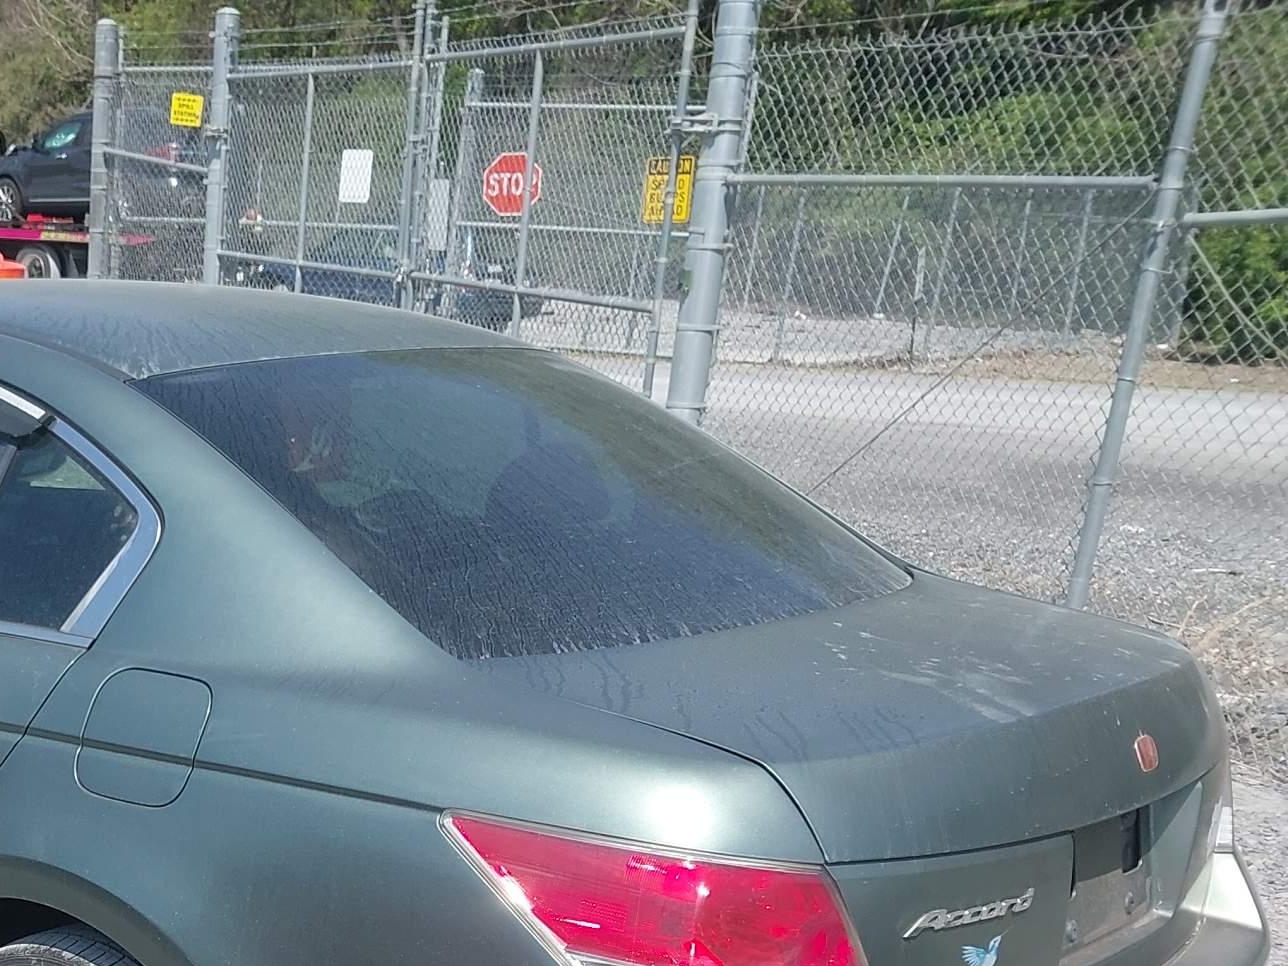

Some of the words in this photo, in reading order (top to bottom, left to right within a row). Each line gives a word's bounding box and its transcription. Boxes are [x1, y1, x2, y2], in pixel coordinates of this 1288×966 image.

[650, 158, 692, 175] CAUON
[651, 178, 685, 191] SPD
[649, 191, 686, 204] BUS
[649, 205, 683, 217] AHD
[901, 887, 1035, 939] Accord
